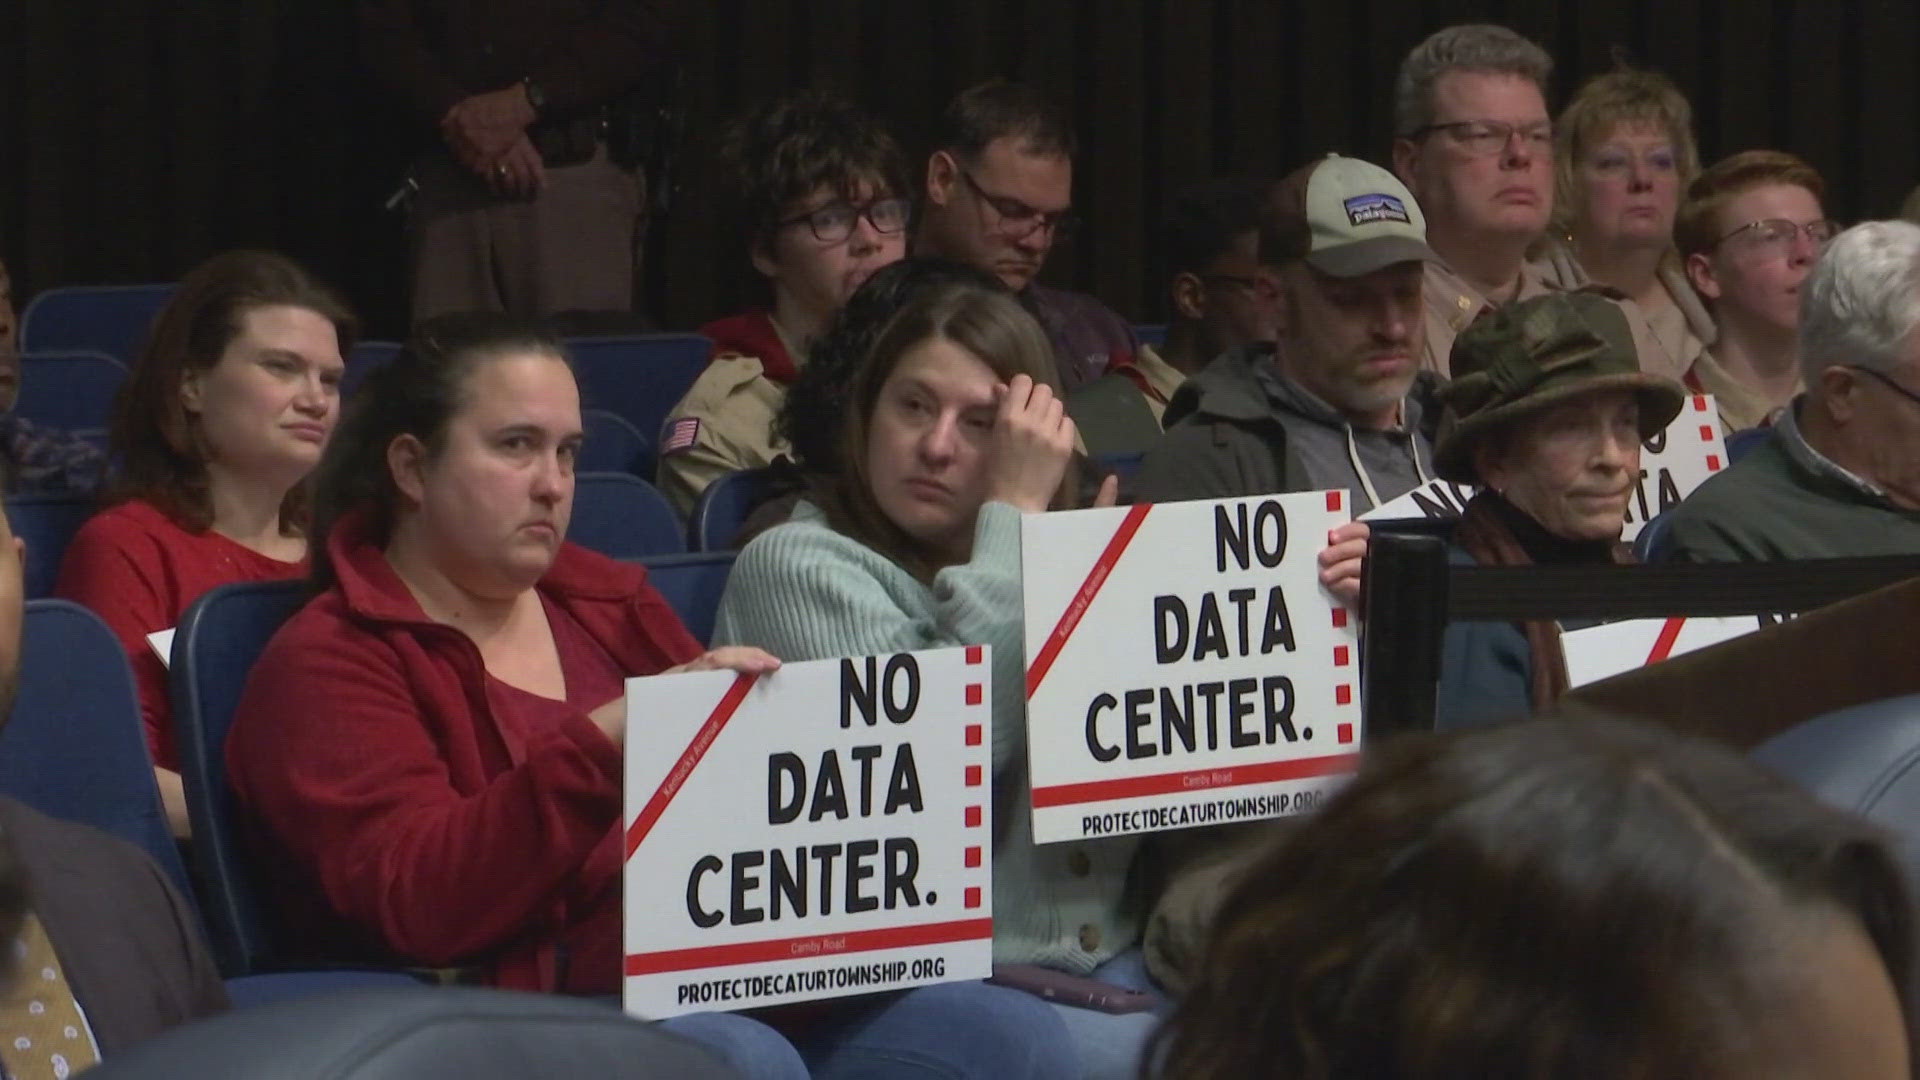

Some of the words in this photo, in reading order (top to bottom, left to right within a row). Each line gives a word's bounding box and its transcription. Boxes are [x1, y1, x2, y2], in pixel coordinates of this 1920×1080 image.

[1214, 500, 1288, 573] NO
[1154, 585, 1297, 665] DATA
[840, 652, 921, 729] NO
[1085, 675, 1313, 763] CENTER.
[767, 742, 924, 825] DATA
[686, 836, 938, 929] CENTER.
[677, 957, 946, 1005] PROTECTDECATURTOWNSHIP.ORG
[791, 941, 820, 955] Camby
[822, 936, 846, 950] Road
